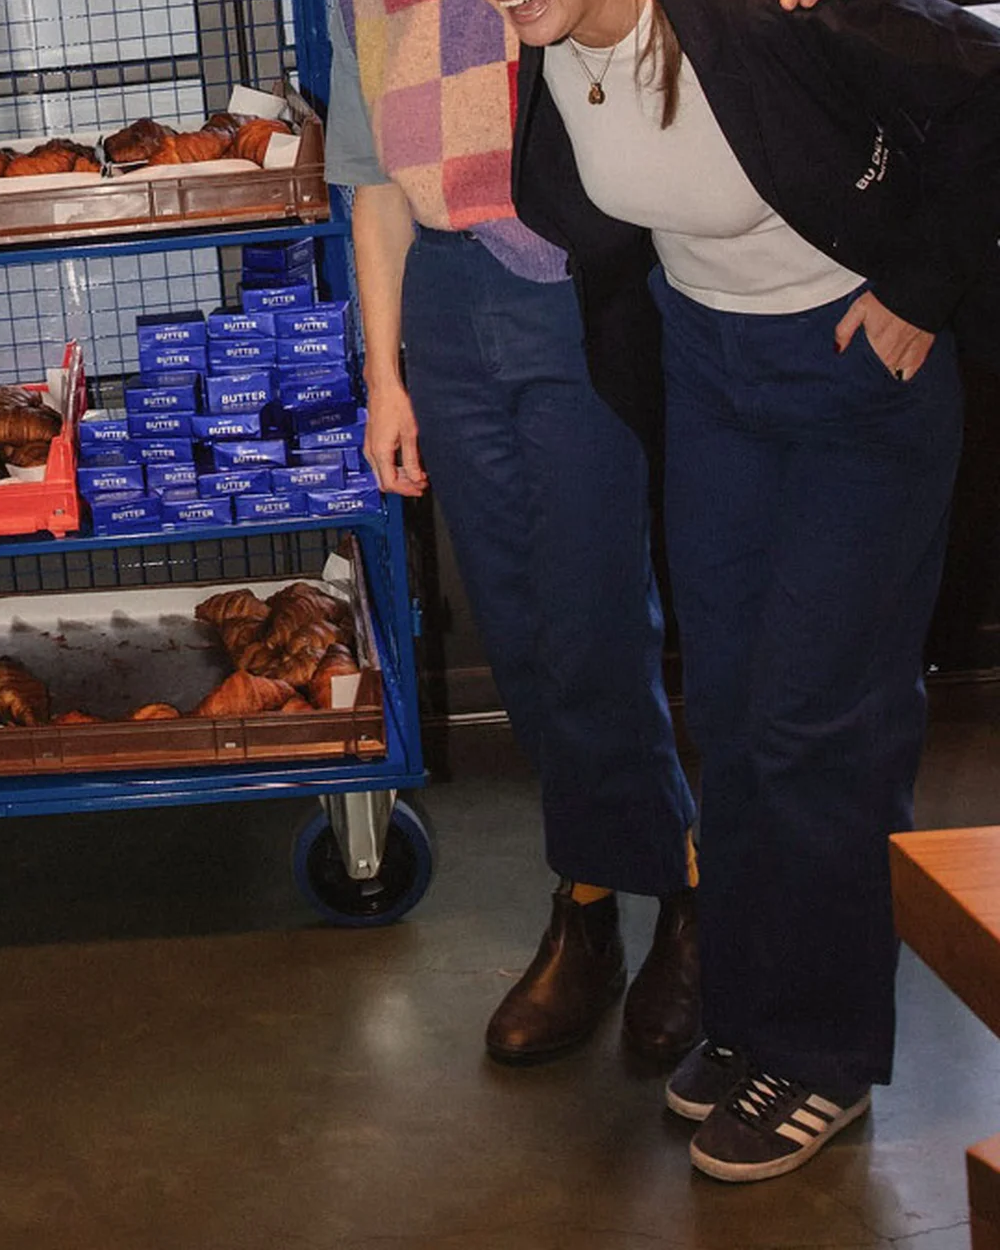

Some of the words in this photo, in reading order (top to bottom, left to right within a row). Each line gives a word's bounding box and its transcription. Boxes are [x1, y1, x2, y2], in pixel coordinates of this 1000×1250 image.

[855, 168, 876, 190] BU
[262, 294, 296, 305] BUTTER
[224, 321, 258, 330] BUTTER
[294, 321, 328, 330] BUTTER
[155, 330, 190, 341] BUTTER
[226, 347, 260, 356] BUTTER
[294, 343, 328, 353] BUTTER
[157, 354, 190, 364] BUTTER
[222, 391, 266, 404] BUTTER
[298, 390, 332, 400] BUTTER
[143, 396, 177, 405] BUTTER
[146, 420, 179, 429] BUTTER
[209, 426, 243, 435] BUTTER
[317, 433, 352, 442] BUTTER
[142, 449, 175, 457] BUTTER
[93, 477, 127, 486] BUTTER
[290, 473, 326, 483] BUTTER
[216, 481, 250, 491] BUTTER
[255, 502, 290, 512] BUTTER
[328, 500, 364, 510] BUTTER
[112, 509, 145, 520] BUTTER
[179, 509, 214, 518] BUTTER
